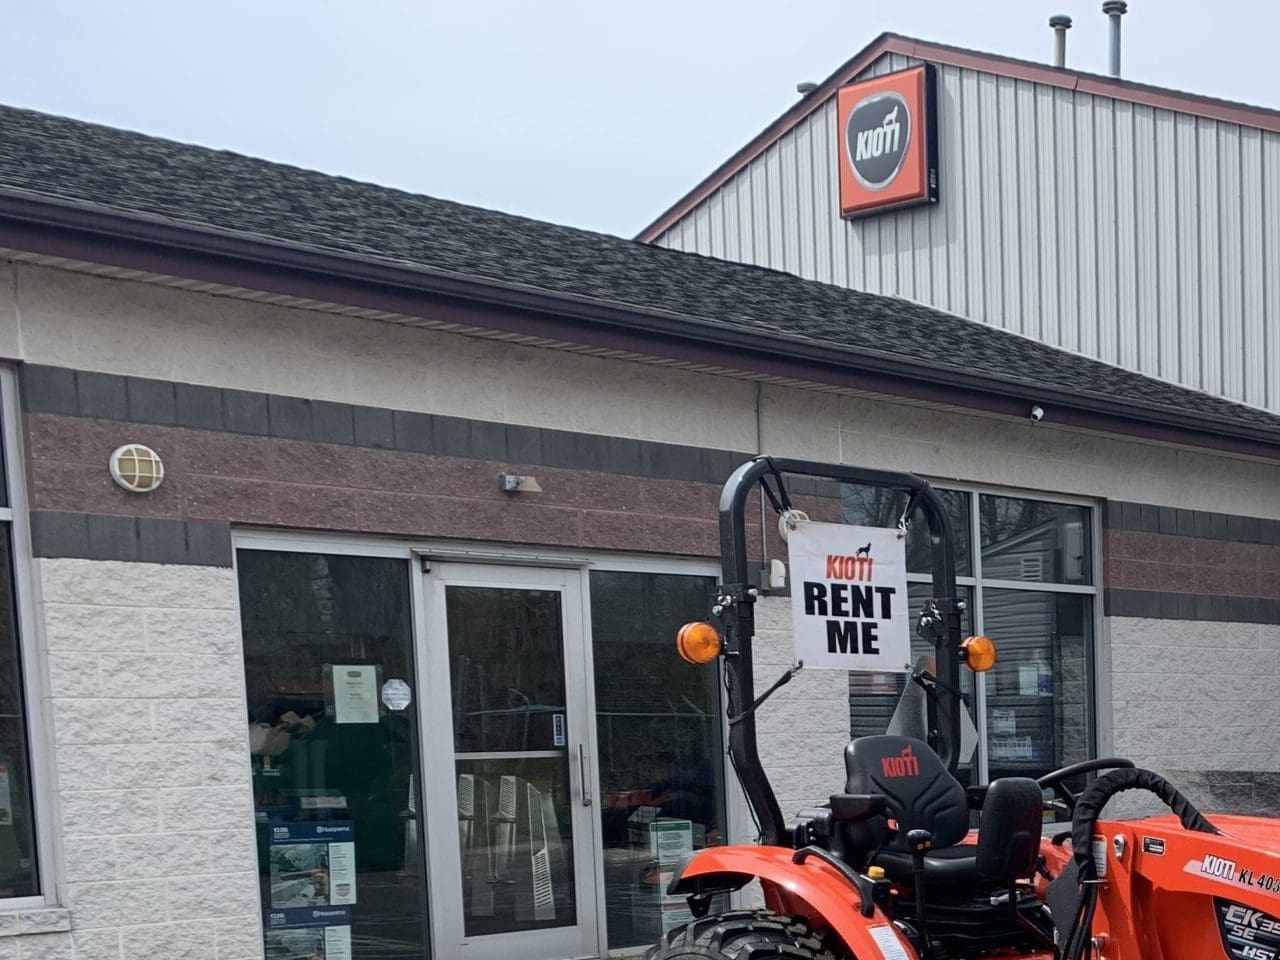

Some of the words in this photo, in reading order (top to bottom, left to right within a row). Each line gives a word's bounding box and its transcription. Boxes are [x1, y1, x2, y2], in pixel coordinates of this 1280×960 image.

[856, 122, 900, 161] KIOTI
[825, 554, 873, 582] KIOTI
[803, 581, 896, 620] RENT
[825, 620, 880, 655] ME
[881, 754, 920, 778] KIOTI
[1201, 854, 1236, 880] KIOTI
[1239, 868, 1254, 886] KL
[1230, 925, 1257, 940] SE
